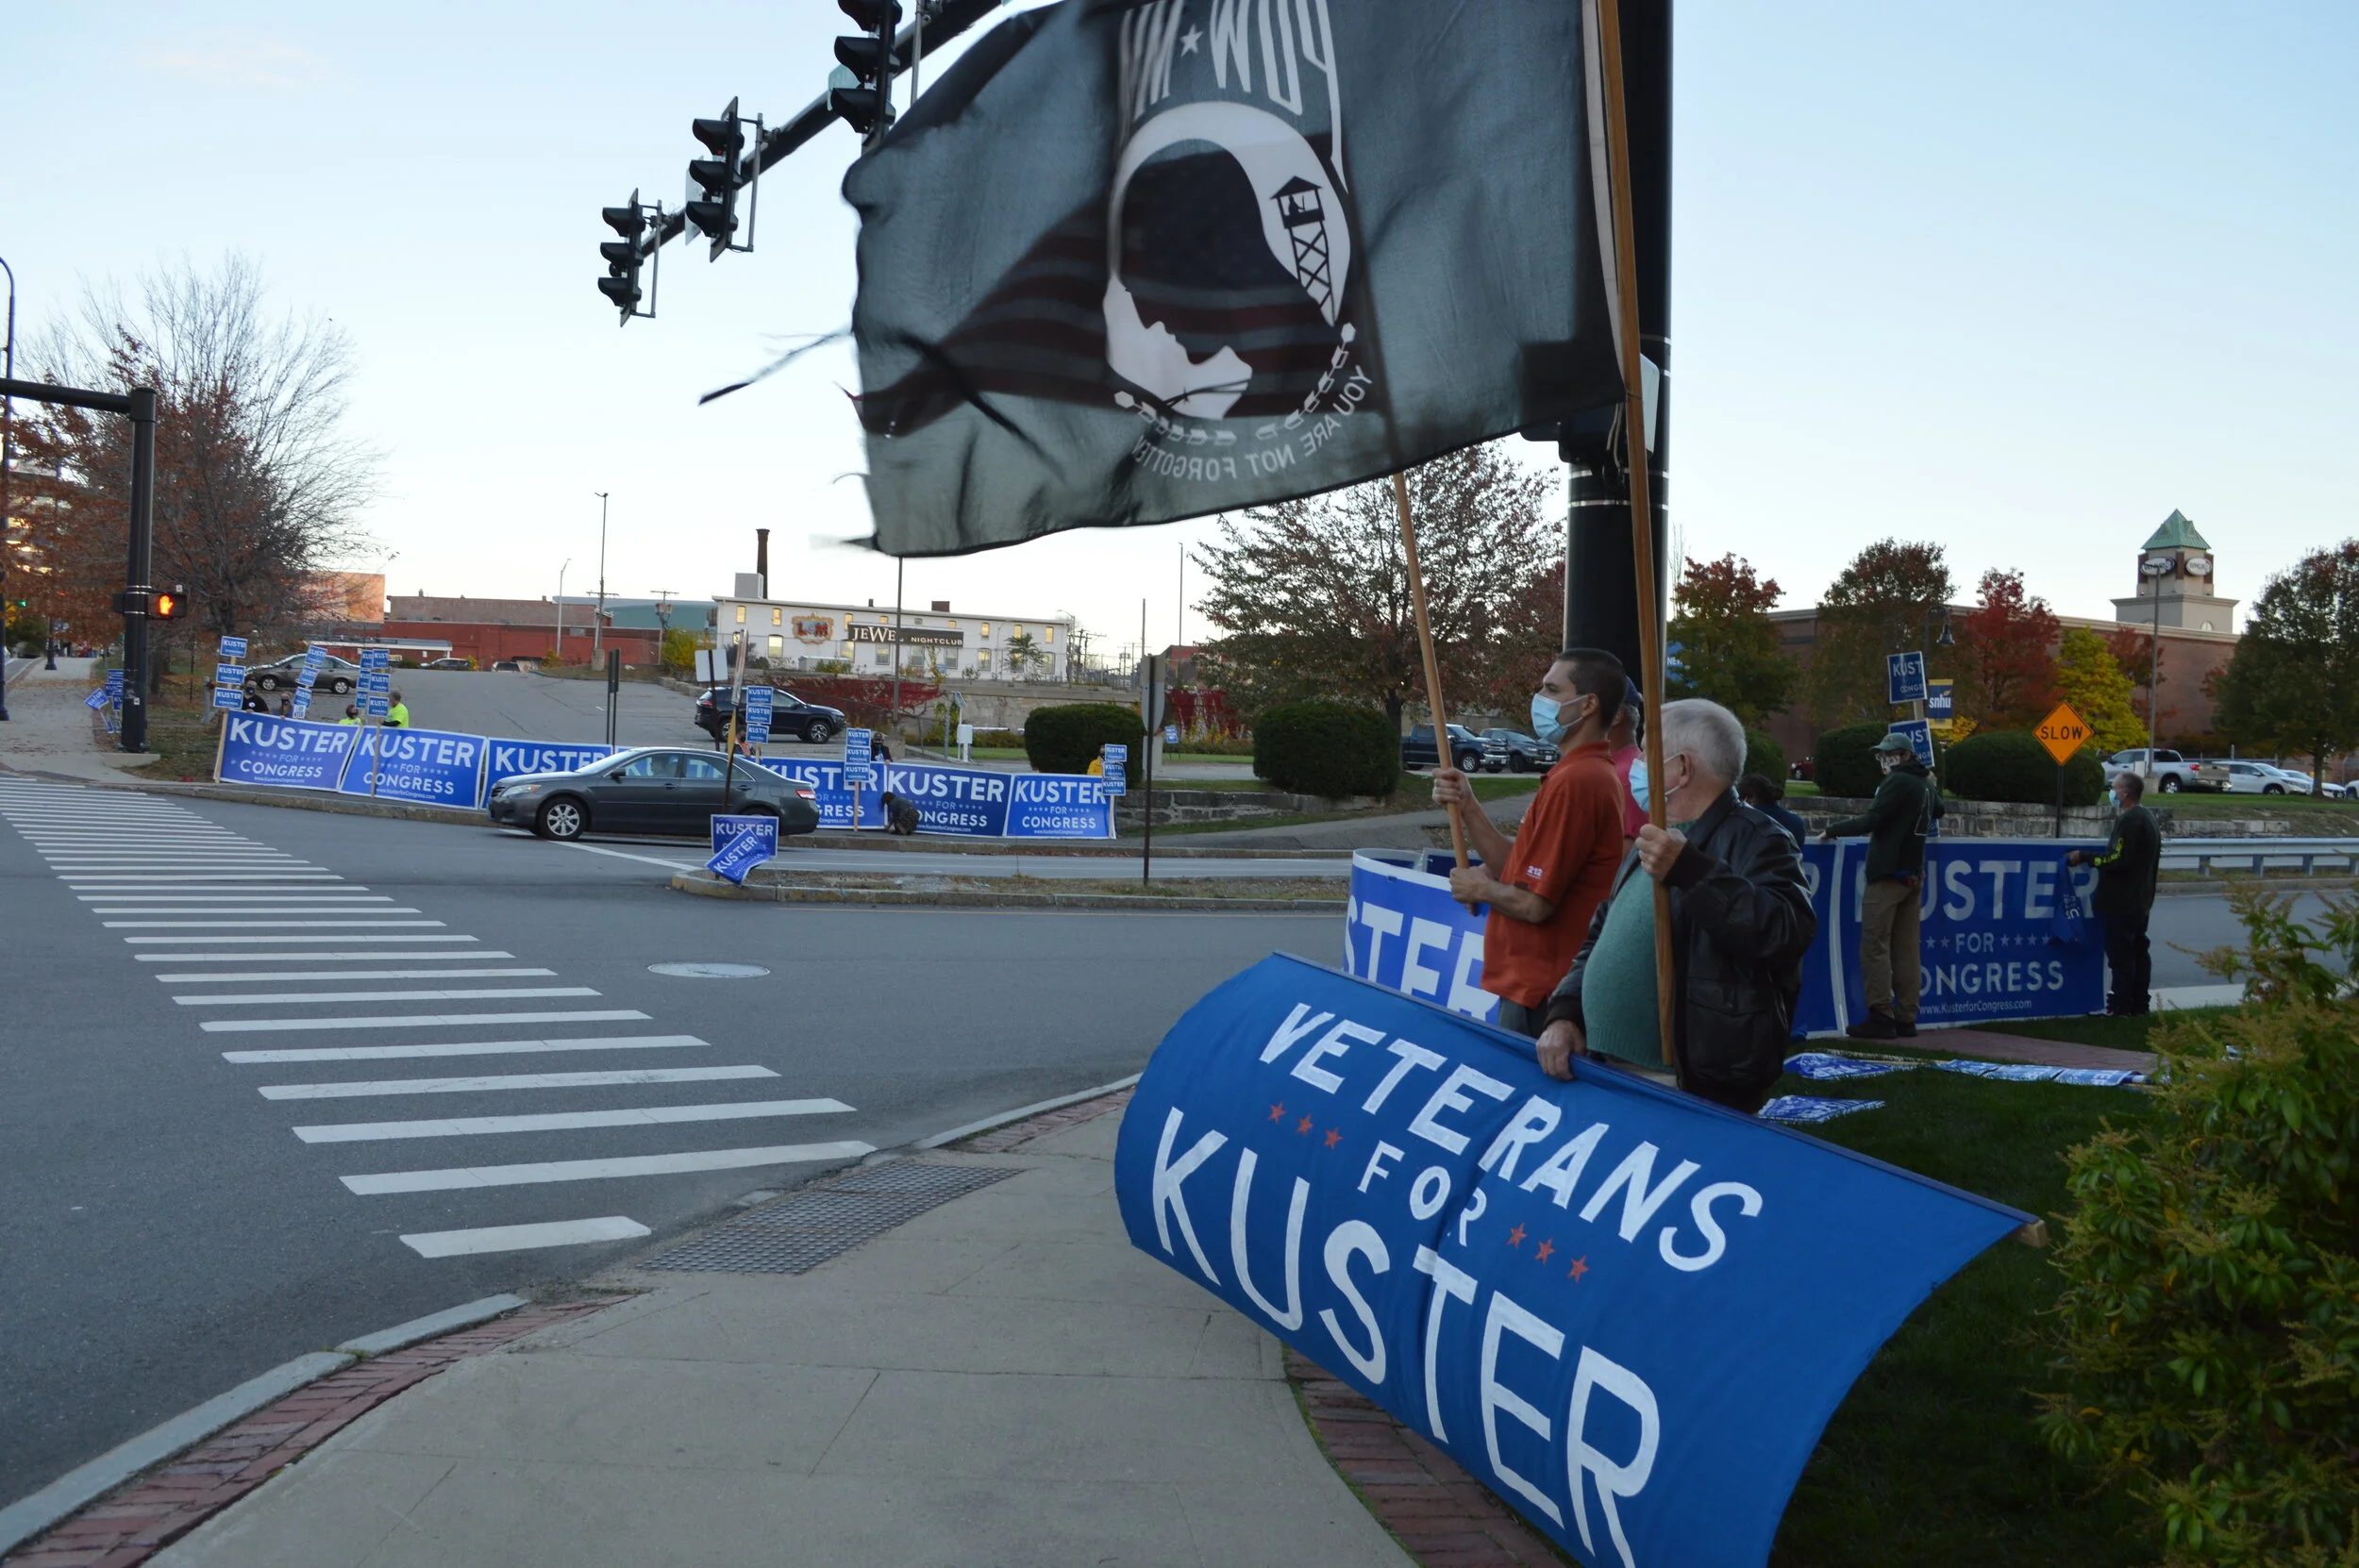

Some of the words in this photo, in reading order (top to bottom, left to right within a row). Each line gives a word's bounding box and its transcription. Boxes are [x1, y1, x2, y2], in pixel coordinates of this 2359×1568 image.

[852, 626, 904, 642] JEWE
[911, 636, 963, 646] NIGHTCLUB
[1929, 693, 1951, 709] snhu
[230, 717, 348, 754] KUSTER
[2040, 726, 2083, 741] SLOW
[279, 754, 299, 763] FOR
[360, 733, 475, 768] KUSTER
[240, 759, 323, 778] CONGRESS
[399, 762, 421, 775] FOR
[363, 772, 455, 795] CONGRESS
[889, 770, 1005, 803] KUSTER
[1014, 780, 1107, 805] KUSTER
[935, 800, 957, 810] FOR
[1049, 806, 1067, 814] FOR
[715, 823, 774, 837] KUSTER
[1022, 816, 1096, 829] CONGRESS
[713, 836, 759, 874] KUSTER
[1955, 932, 1995, 954] FOR
[1259, 1002, 1764, 1272] VETERANS
[1357, 1140, 1487, 1246] FOR
[1151, 1106, 1661, 1568] KUSTER
